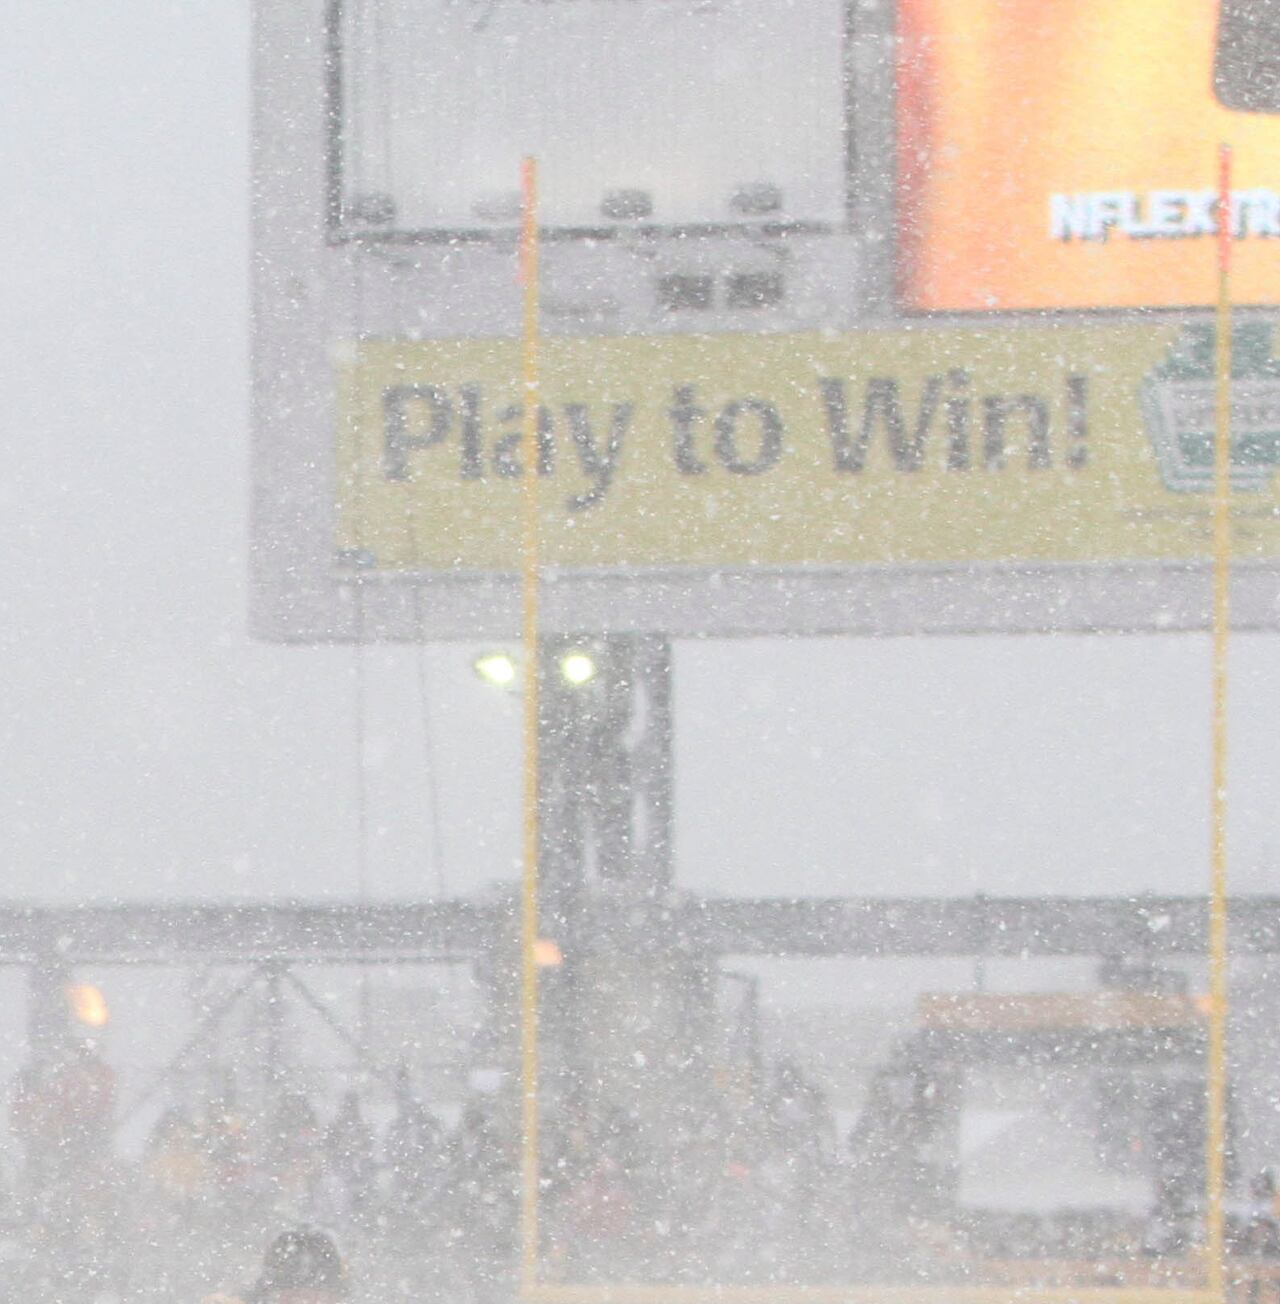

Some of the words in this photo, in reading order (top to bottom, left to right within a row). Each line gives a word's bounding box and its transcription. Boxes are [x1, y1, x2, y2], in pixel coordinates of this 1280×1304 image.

[383, 381, 632, 512] Play
[667, 384, 782, 476] to
[817, 368, 1088, 473] Win!
